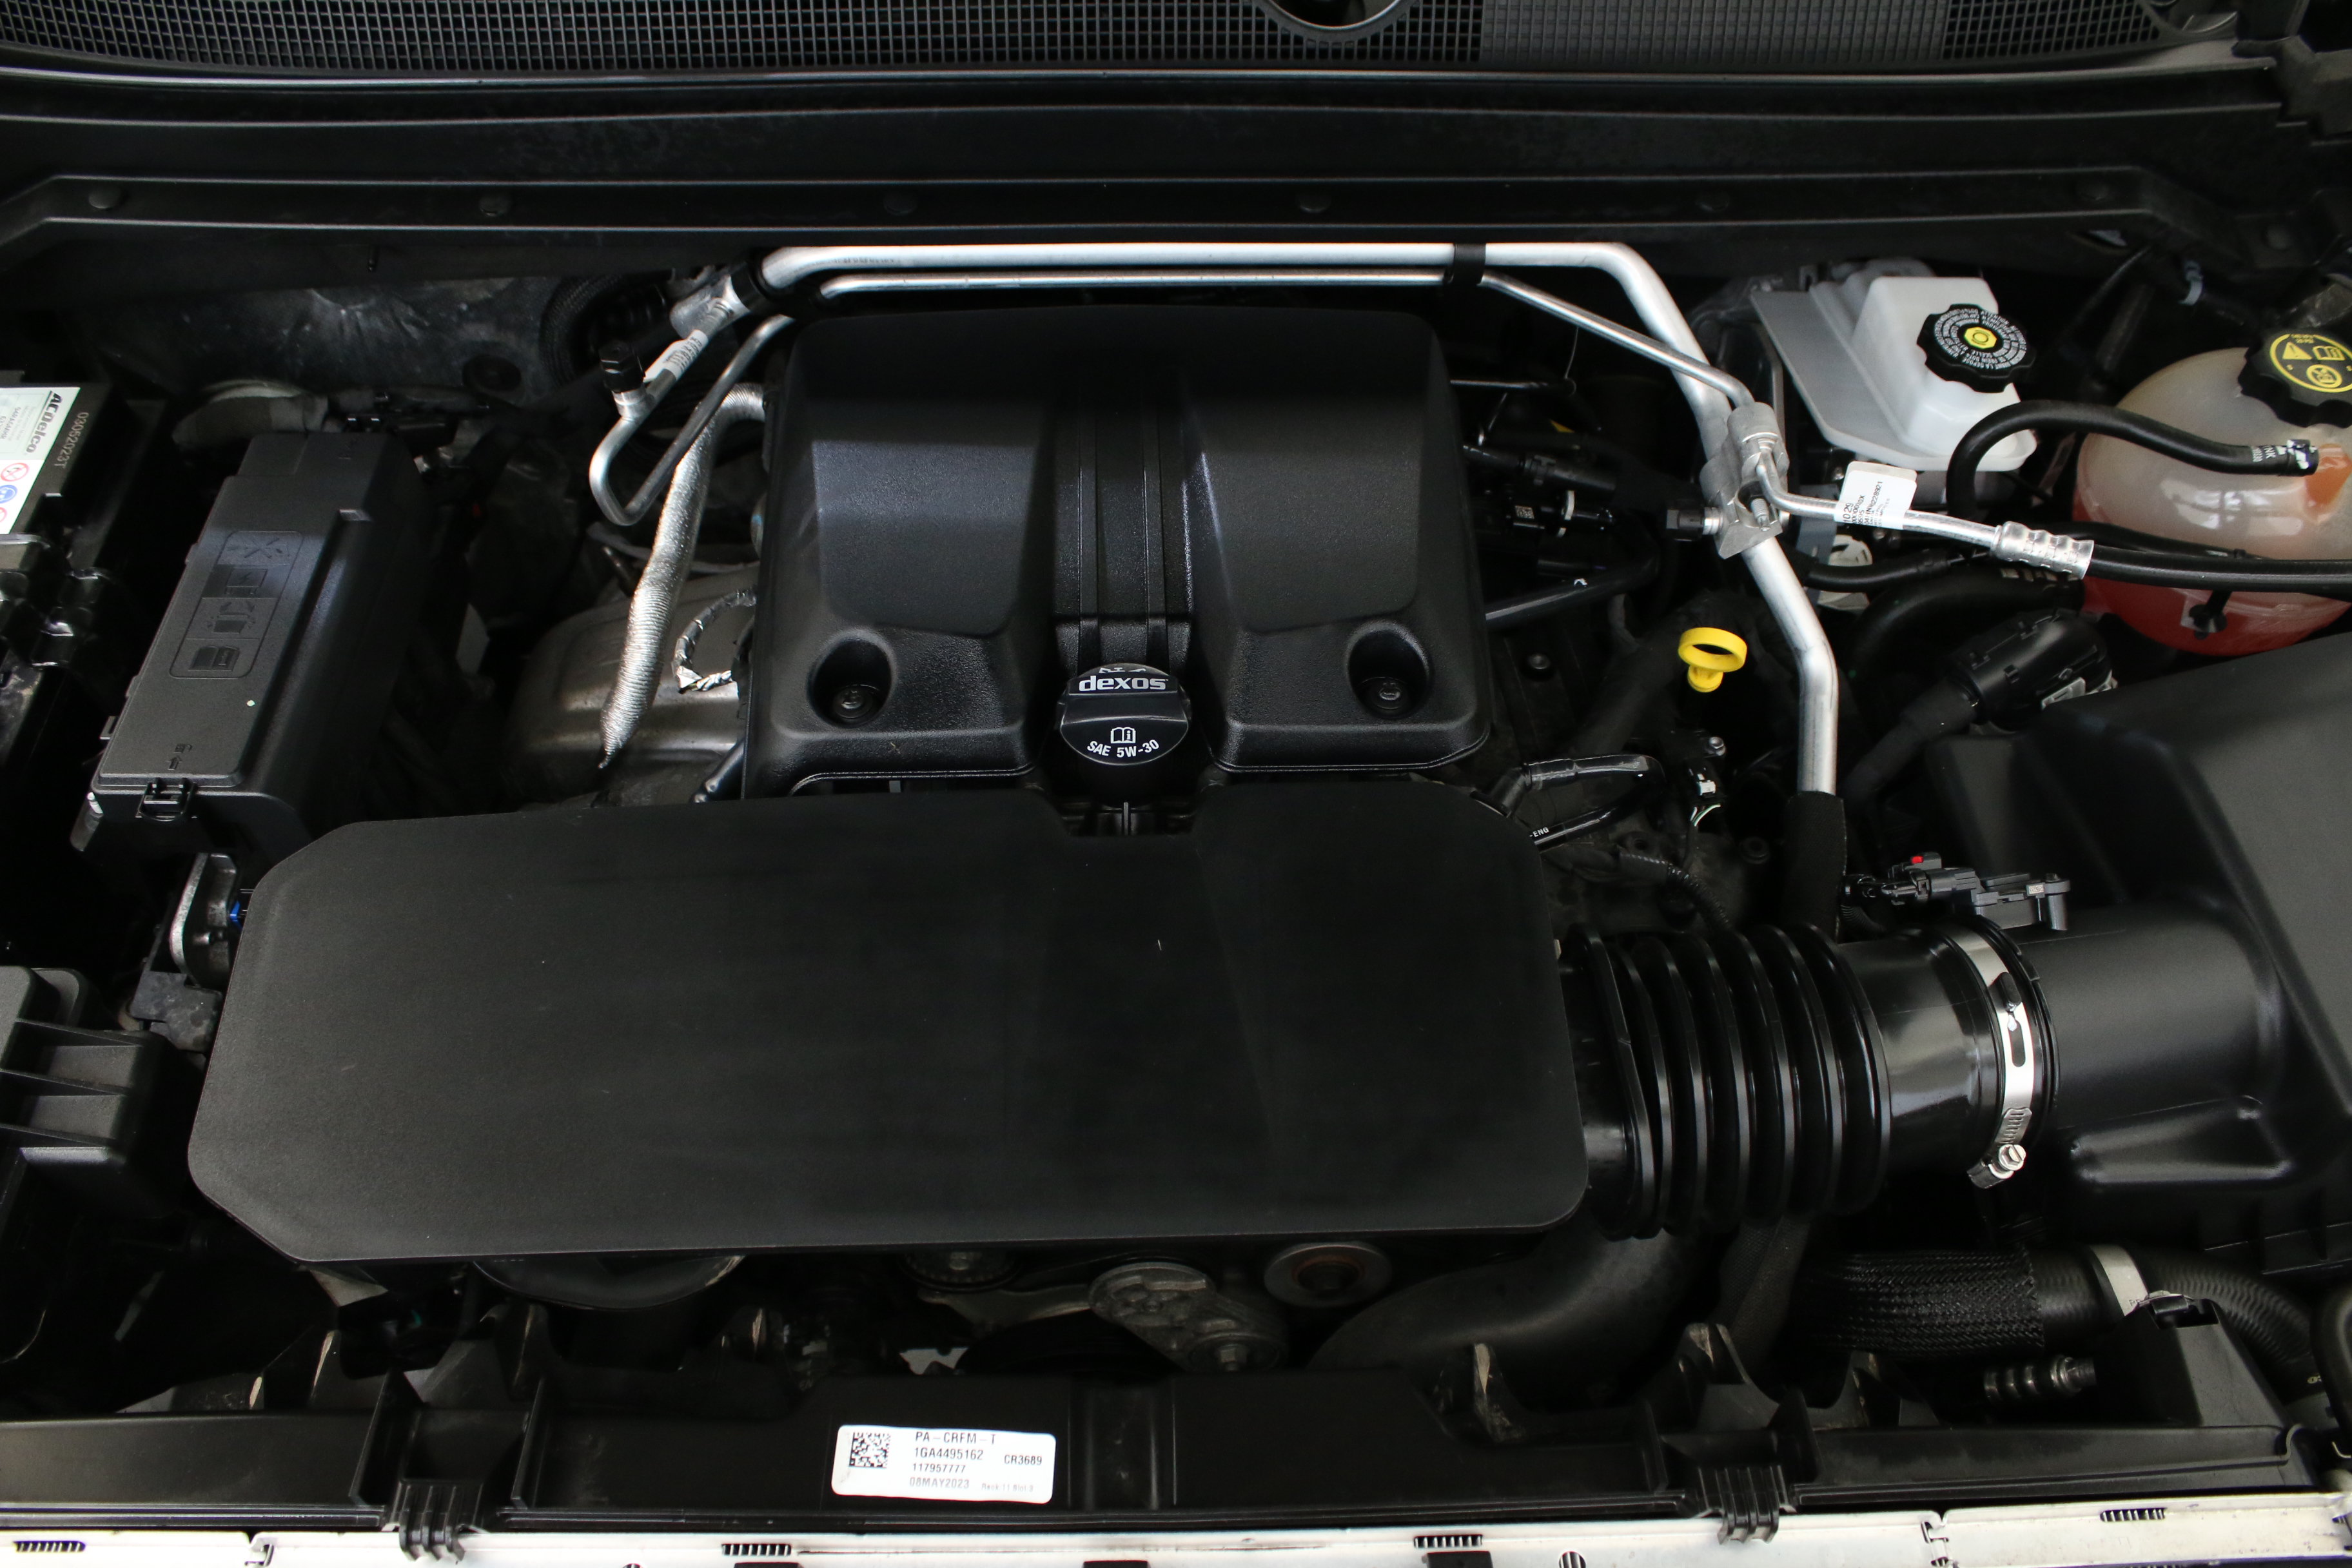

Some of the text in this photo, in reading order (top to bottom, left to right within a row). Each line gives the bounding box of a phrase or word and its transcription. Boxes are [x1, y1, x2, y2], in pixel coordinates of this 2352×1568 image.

[26, 393, 63, 453] ACDelco
[54, 411, 88, 469] 03052023T
[1079, 676, 1165, 691] dexos
[1087, 739, 1160, 758] SAE 5W-30
[914, 1447, 984, 1460] 1GA4495162
[1004, 1455, 1043, 1465] CR3689
[912, 1464, 966, 1473] 117957777
[909, 1476, 970, 1489] 08MAY2023
